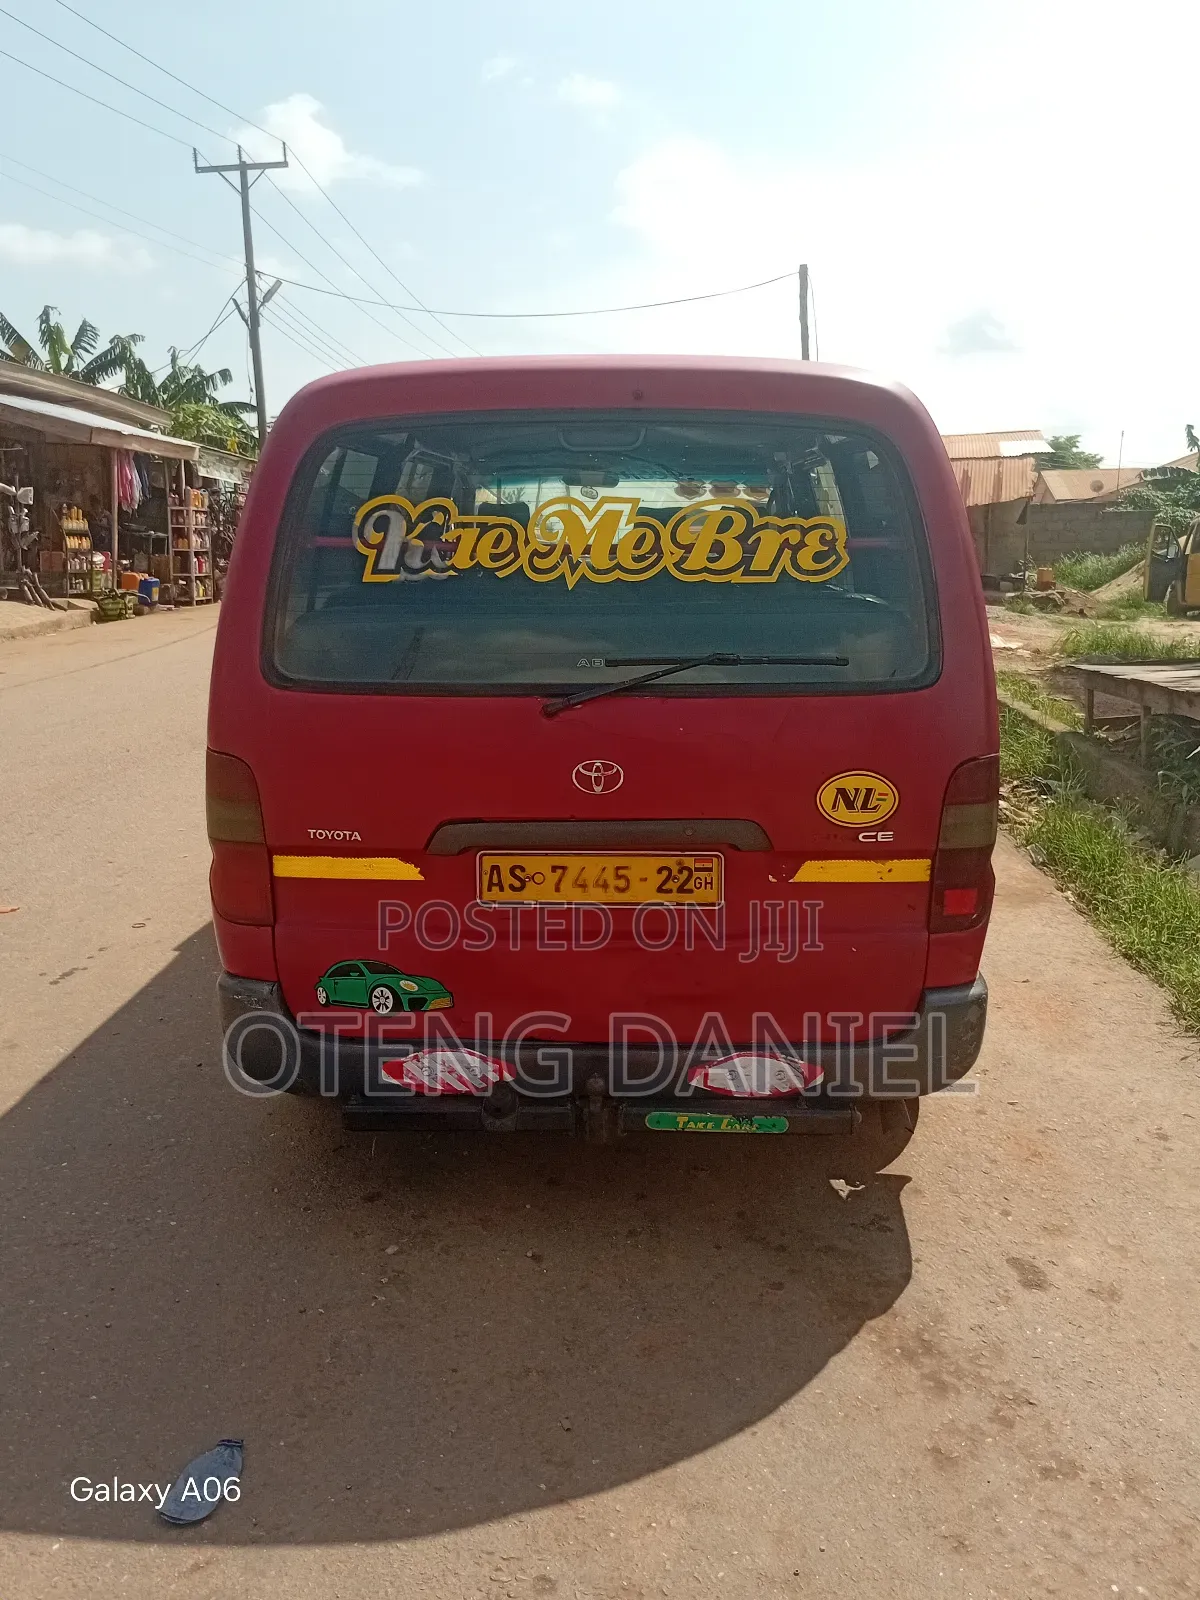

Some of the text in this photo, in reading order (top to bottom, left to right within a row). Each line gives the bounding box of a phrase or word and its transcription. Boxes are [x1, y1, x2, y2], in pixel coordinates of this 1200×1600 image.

[524, 496, 665, 590] Me
[577, 658, 605, 668] AB
[307, 829, 362, 841] TOYOTA
[858, 831, 894, 842] CE
[487, 864, 526, 893] AS
[694, 877, 713, 890] GH
